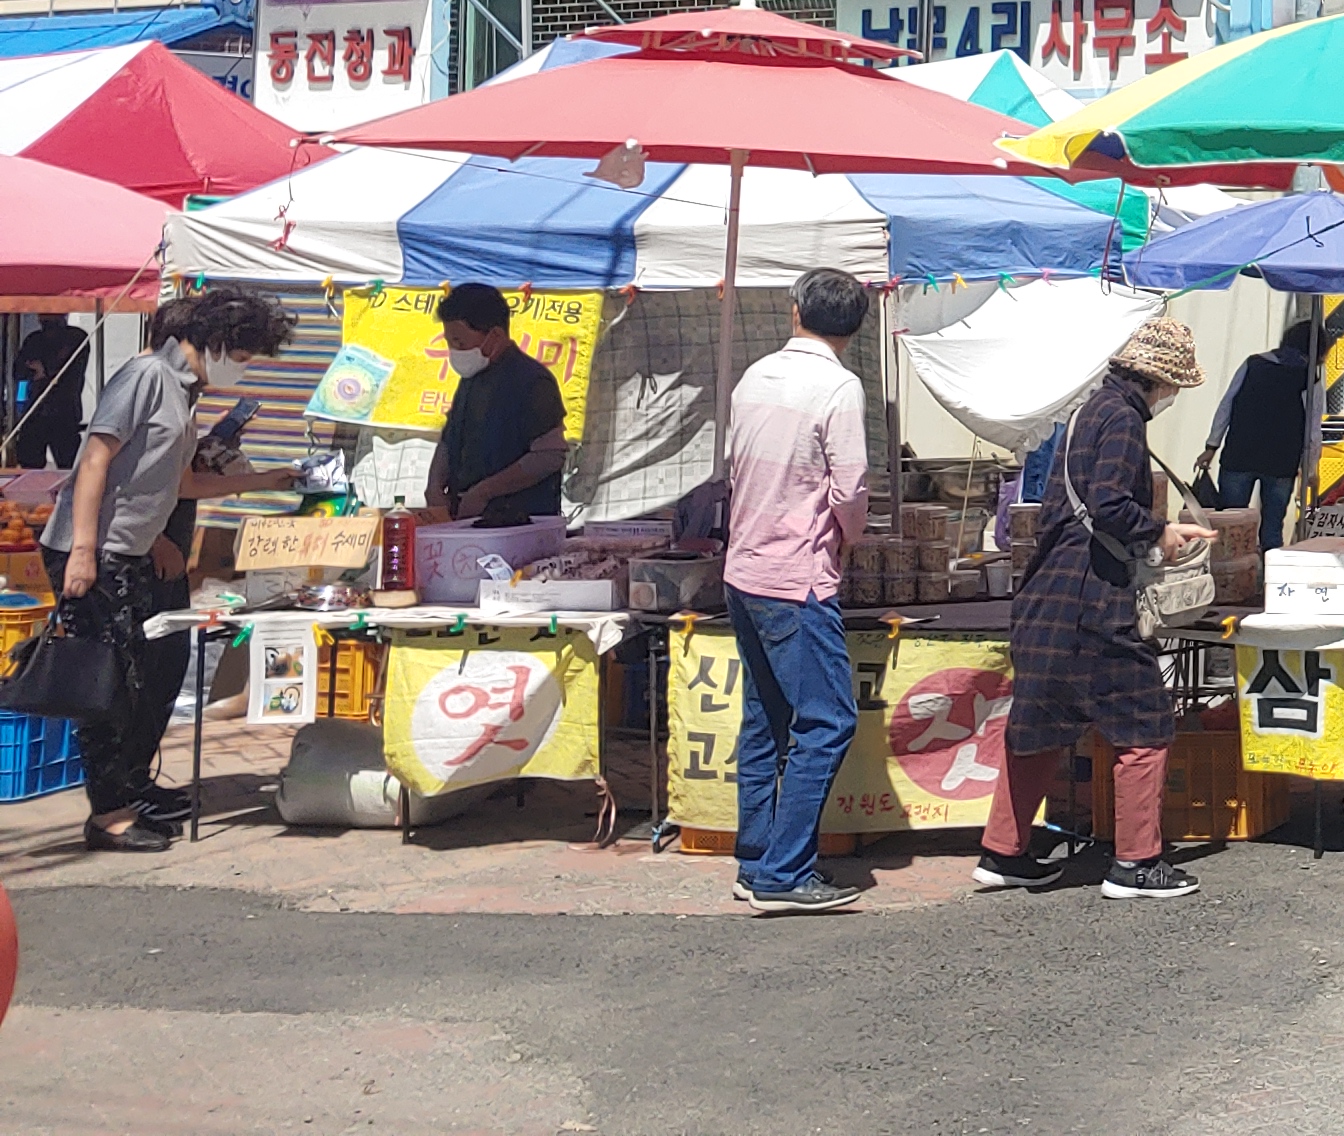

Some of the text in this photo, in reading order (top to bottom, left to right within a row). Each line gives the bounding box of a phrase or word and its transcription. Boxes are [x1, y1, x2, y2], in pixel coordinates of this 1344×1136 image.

[266, 26, 416, 84] 동진청과
[438, 664, 533, 767] 엿
[1246, 649, 1332, 733] 삼
